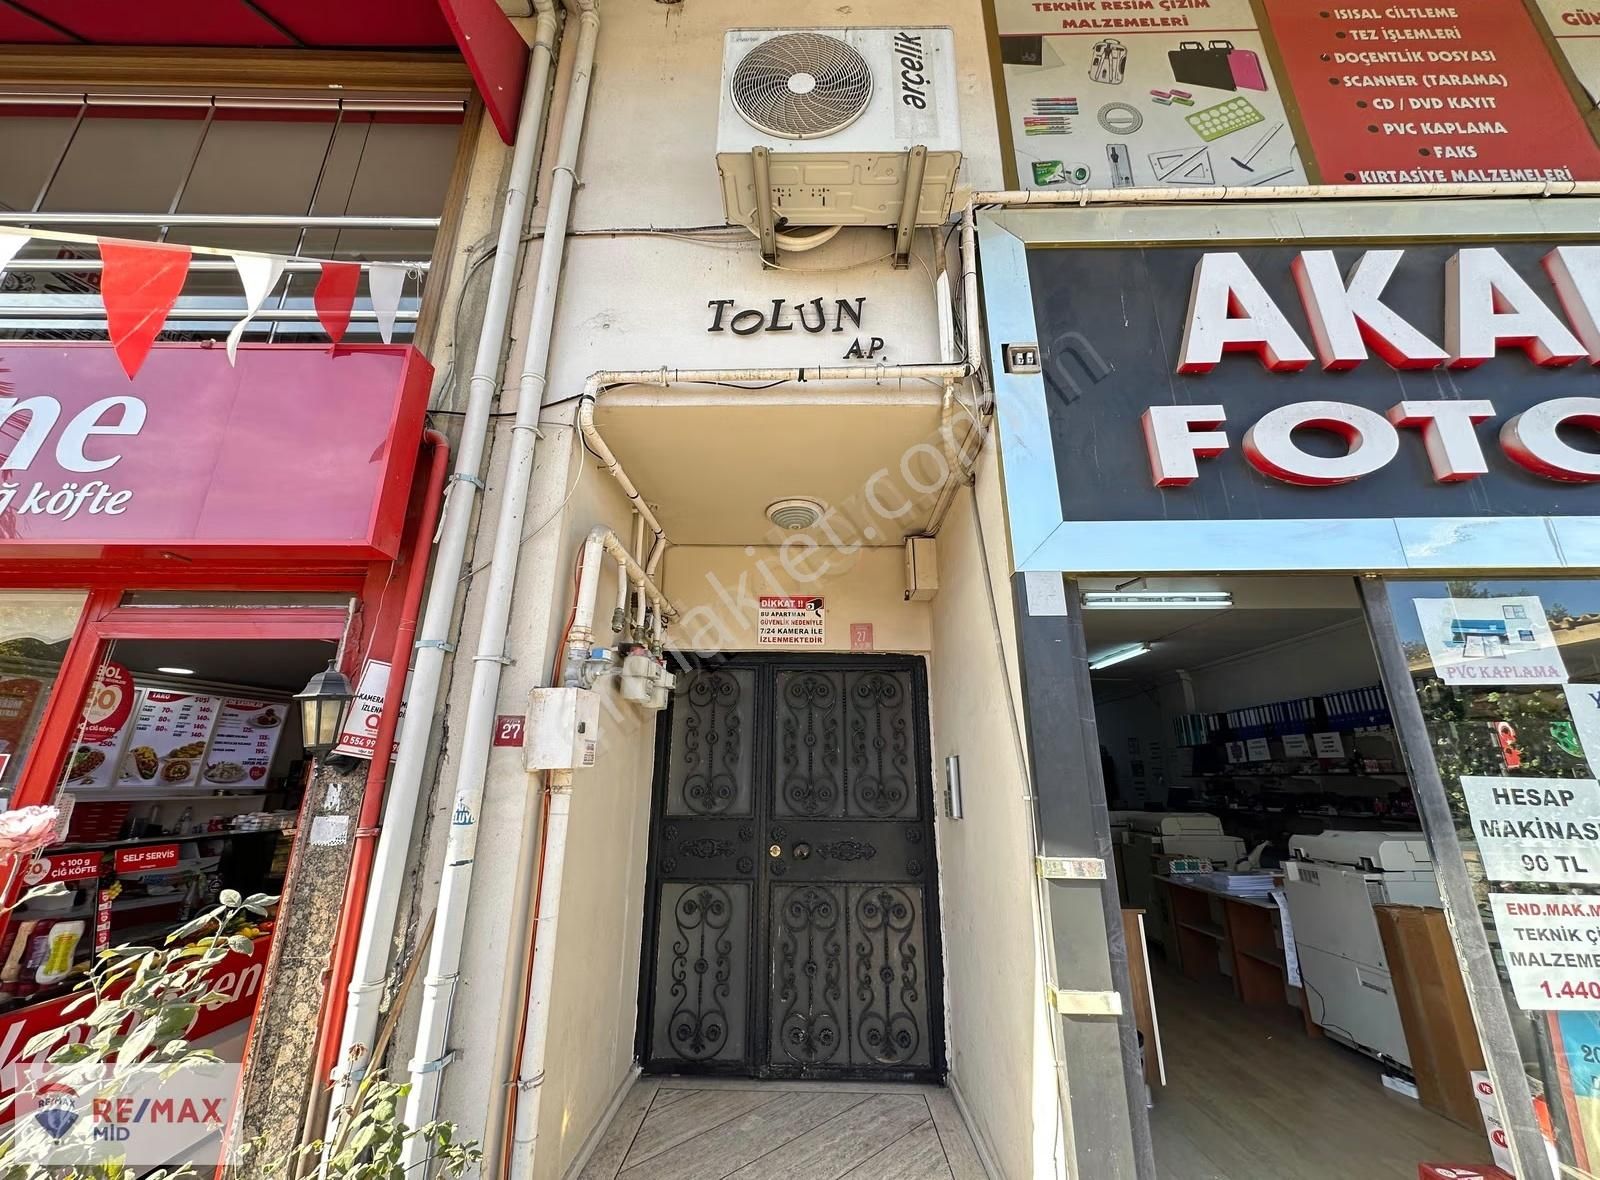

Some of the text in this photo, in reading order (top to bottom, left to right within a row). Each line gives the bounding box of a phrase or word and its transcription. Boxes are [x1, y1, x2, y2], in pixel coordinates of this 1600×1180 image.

[1334, 6, 1458, 20] ISISAL CİLTLEME
[1062, 15, 1189, 29] MALZEMELERİ
[1350, 26, 1462, 43] TEZ İŞLEMLERİ
[1334, 49, 1496, 66] DOÇENTLİK DOSYASI
[893, 32, 931, 110] arçelik
[1343, 74, 1508, 88] SCANNER (TARAMA)
[1372, 98, 1394, 110] CD
[1411, 98, 1444, 110] DVD
[1448, 97, 1496, 109] KAYIT
[1383, 122, 1508, 135] PVC KAPLAMA
[1433, 146, 1478, 159] FAKS
[1358, 165, 1573, 184] KIRTASİYE MALZEMELERİ
[17, 481, 133, 521] köfte
[761, 598, 796, 608] DİKKAT
[811, 627, 823, 635] İLE
[1447, 665, 1561, 679] PVC KAPLAMA
[501, 723, 520, 739] 27
[1492, 788, 1575, 807] HESAP
[68, 859, 84, 867] 100
[123, 851, 175, 863] SELF SERVİS
[1554, 856, 1588, 872] TL
[69, 865, 97, 876] KÖFTE
[1513, 925, 1583, 942] TEKNİK
